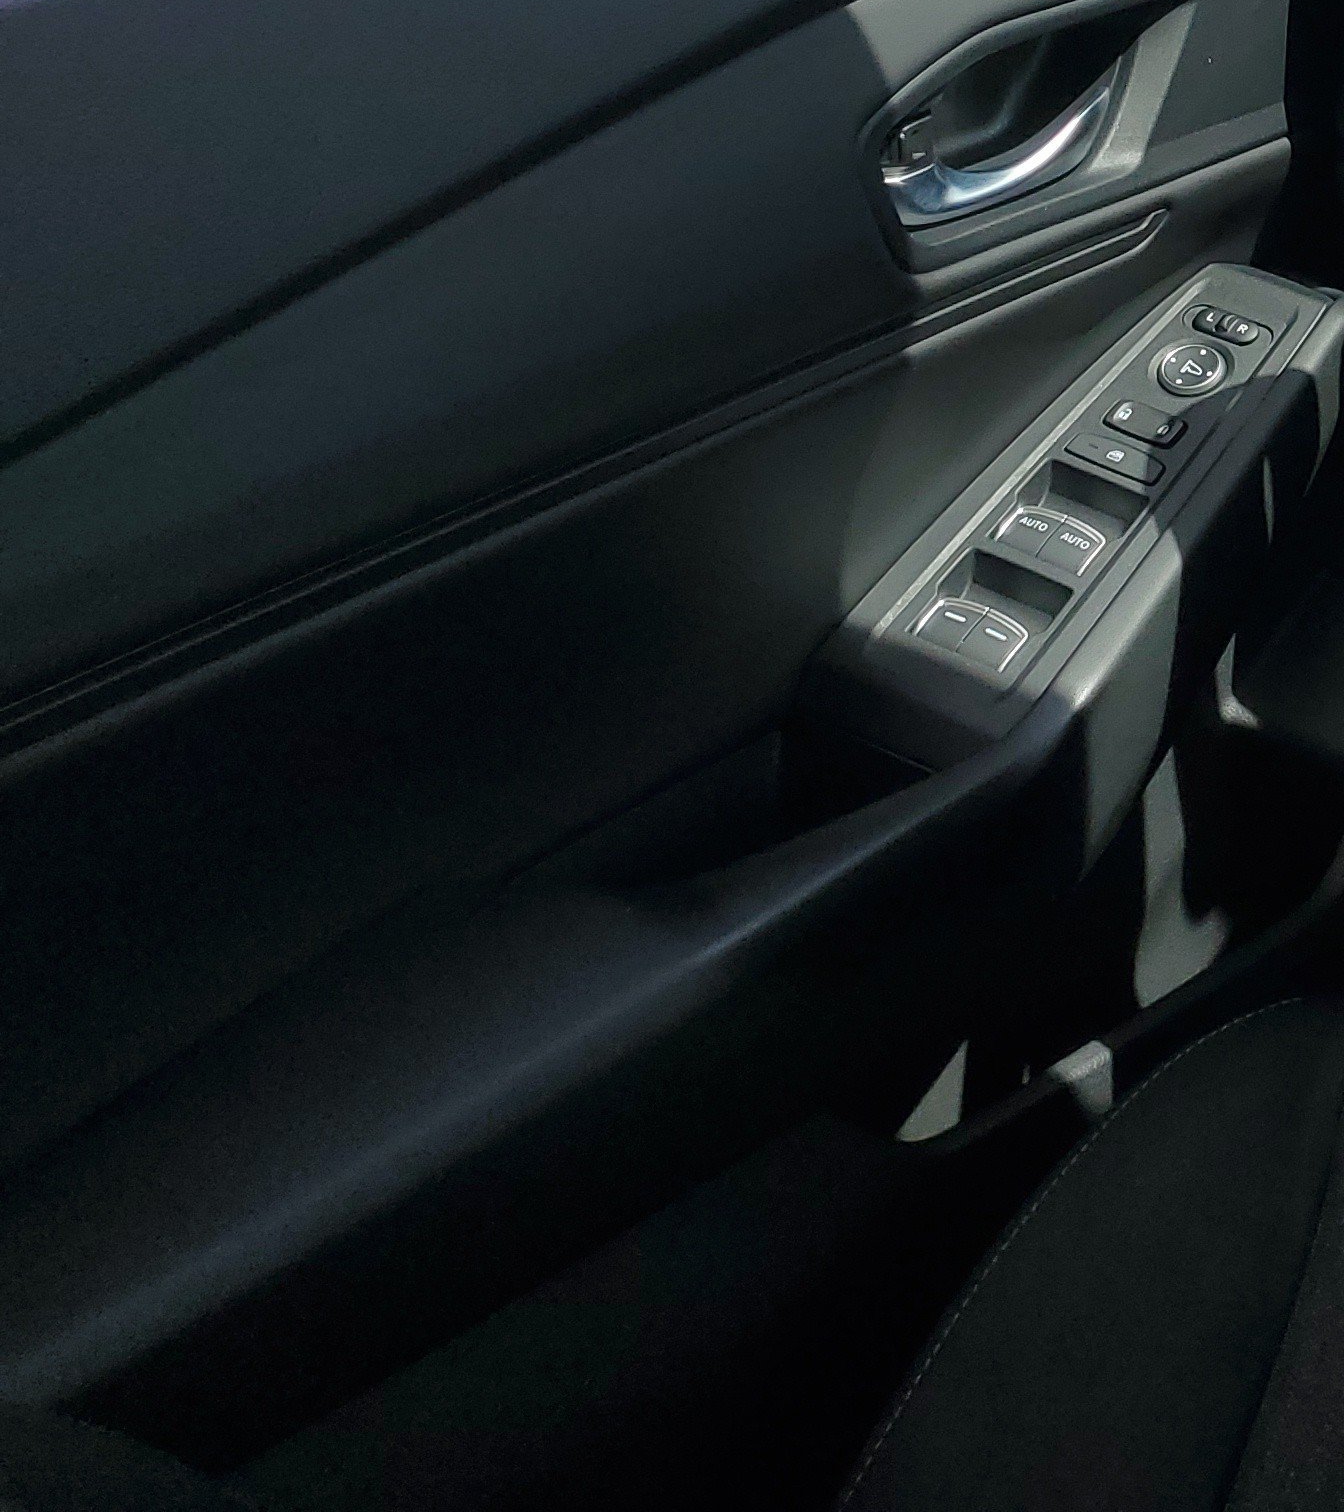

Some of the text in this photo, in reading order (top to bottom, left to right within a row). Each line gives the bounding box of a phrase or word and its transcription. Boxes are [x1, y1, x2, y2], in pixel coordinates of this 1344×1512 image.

[1206, 311, 1215, 323] L
[1236, 323, 1249, 335] R
[1019, 516, 1049, 532] AUTO
[1060, 532, 1091, 549] AUTO
